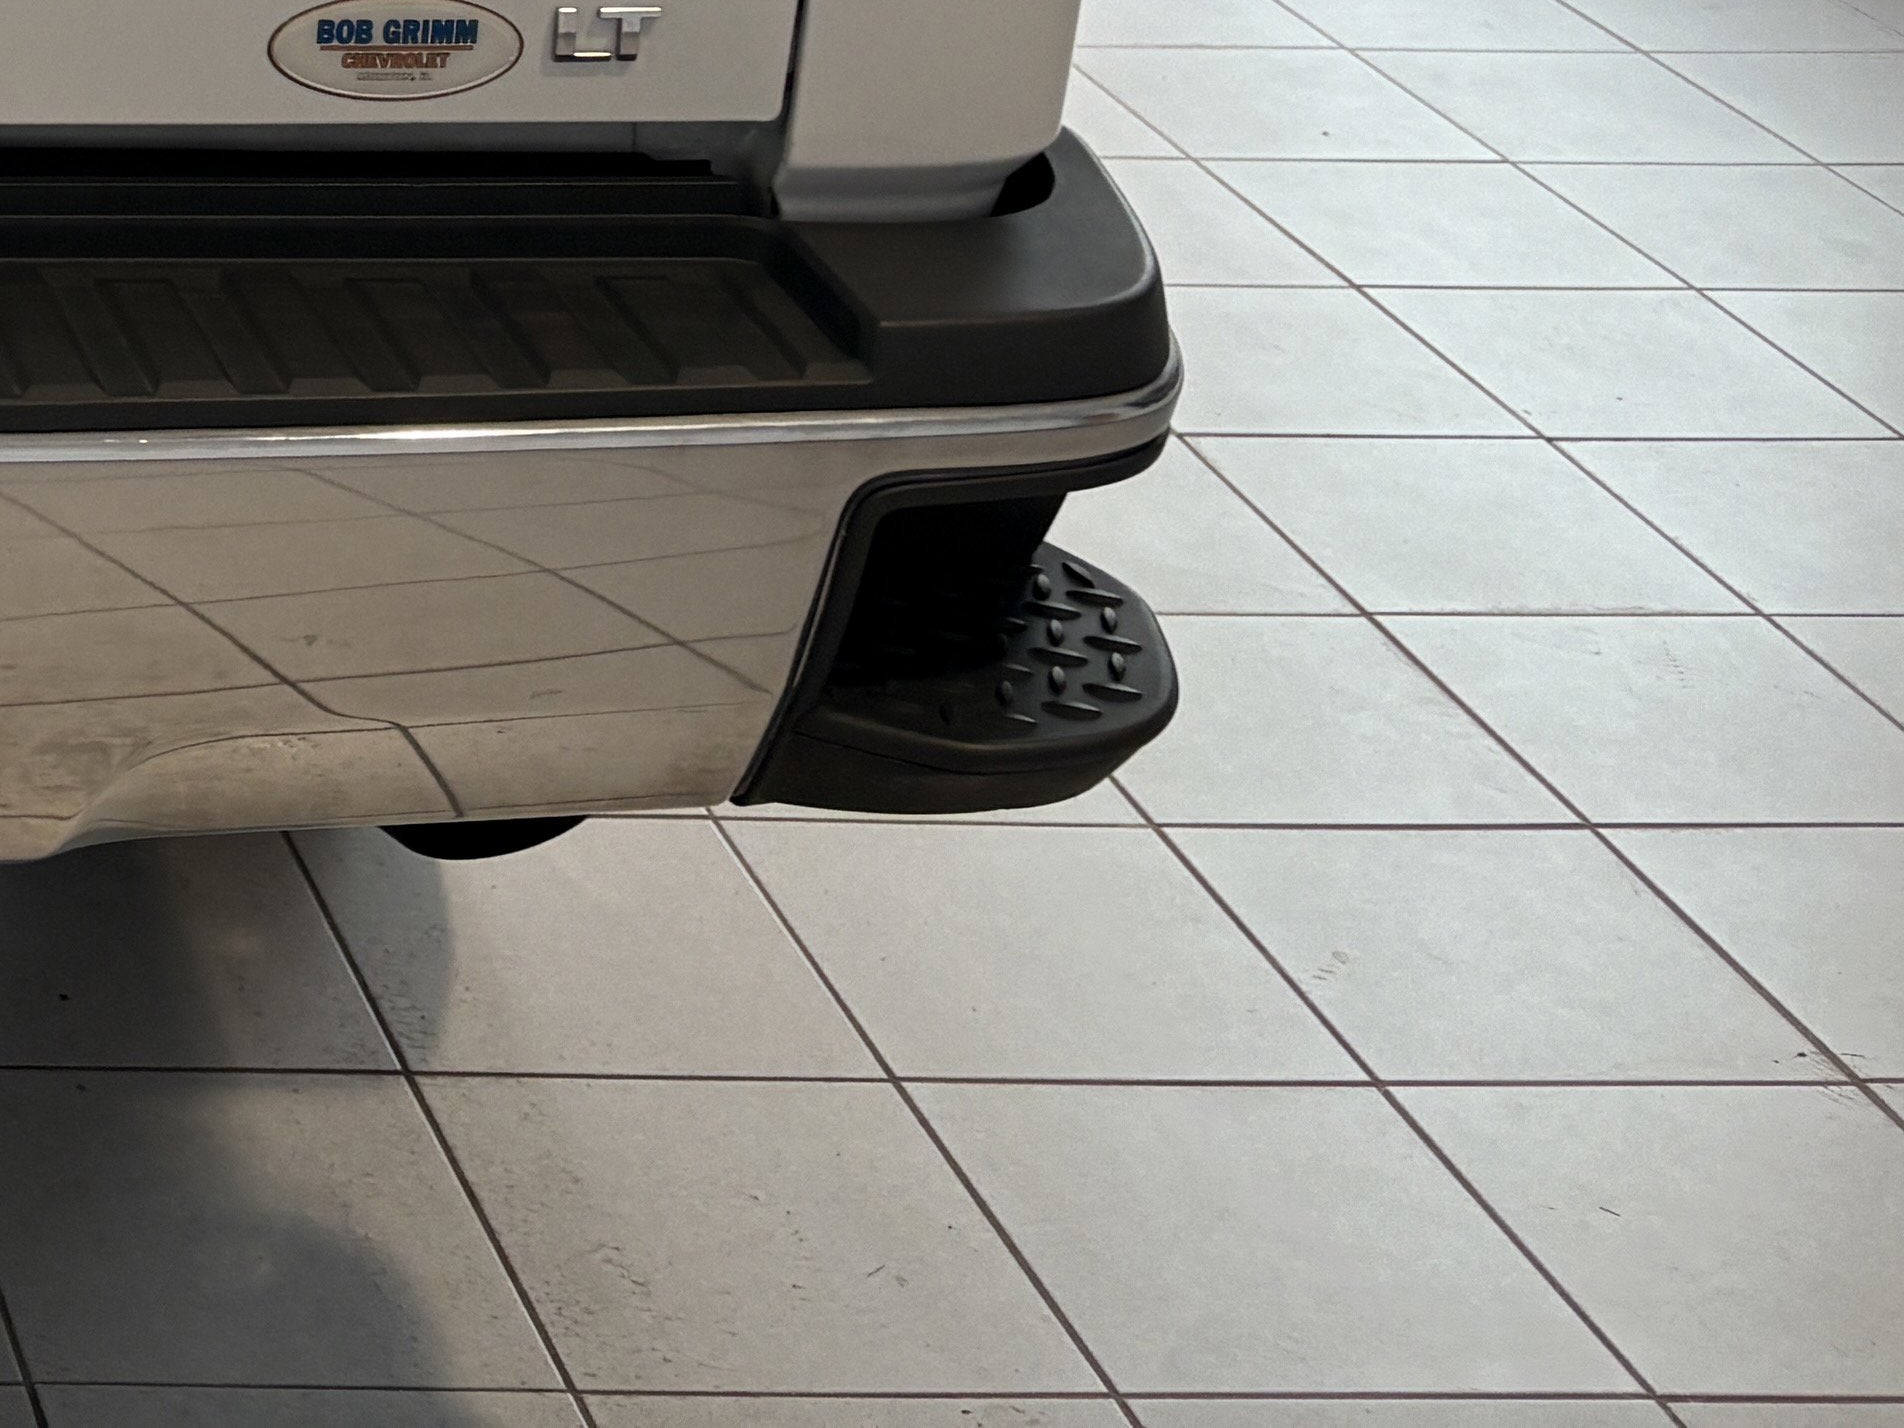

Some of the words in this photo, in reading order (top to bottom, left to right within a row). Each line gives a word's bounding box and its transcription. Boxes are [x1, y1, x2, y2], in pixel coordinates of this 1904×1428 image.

[317, 19, 373, 44] BOB
[383, 19, 479, 44] GRIMM
[553, 6, 662, 61] LT
[342, 52, 450, 68] CHEVROLET
